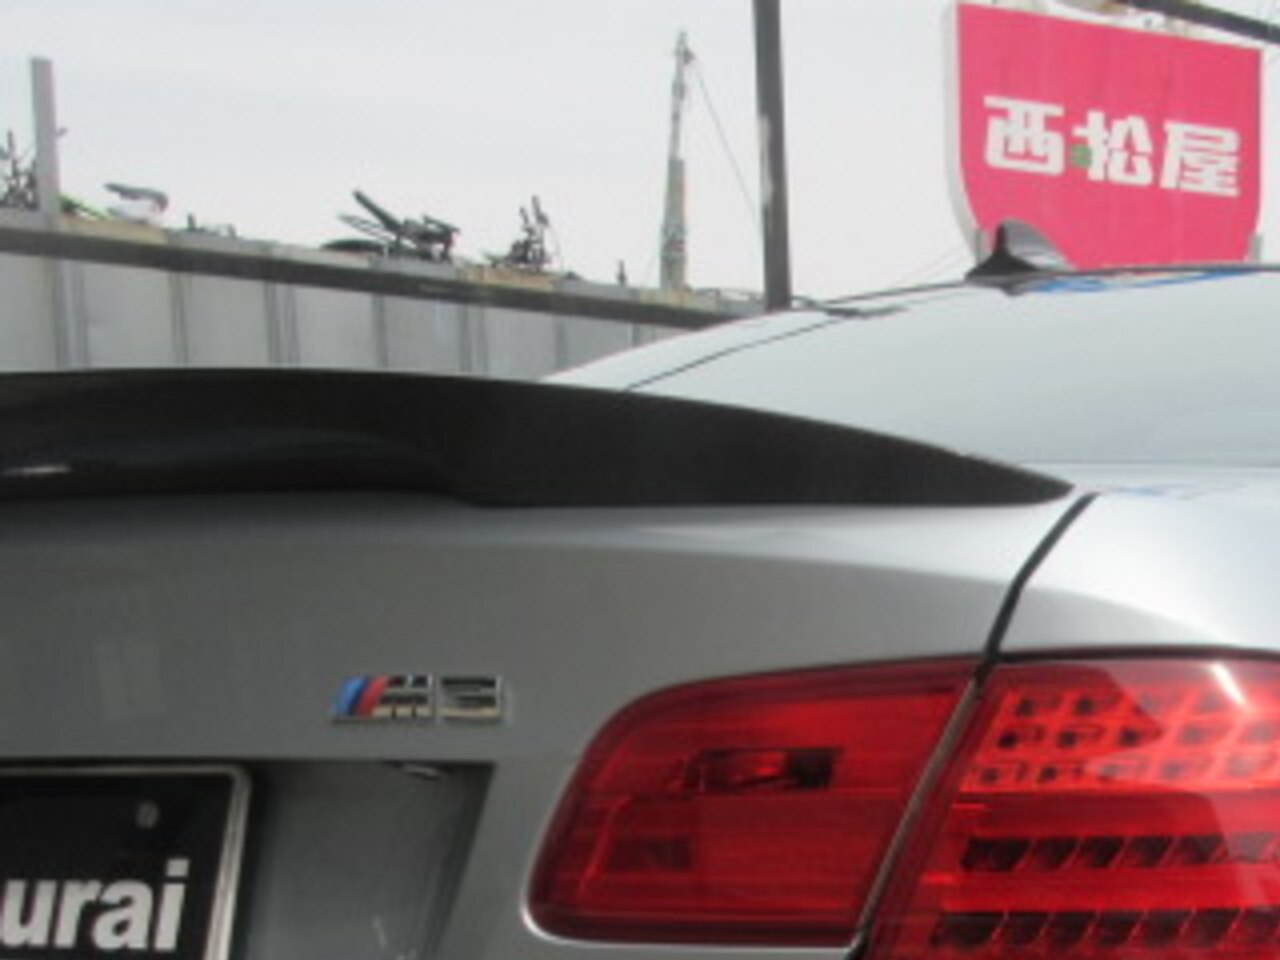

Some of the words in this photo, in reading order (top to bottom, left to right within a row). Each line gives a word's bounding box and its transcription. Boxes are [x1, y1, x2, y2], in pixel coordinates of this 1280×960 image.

[982, 94, 1241, 198] 西松屋
[340, 674, 506, 721] M3
[0, 857, 190, 951] urai
